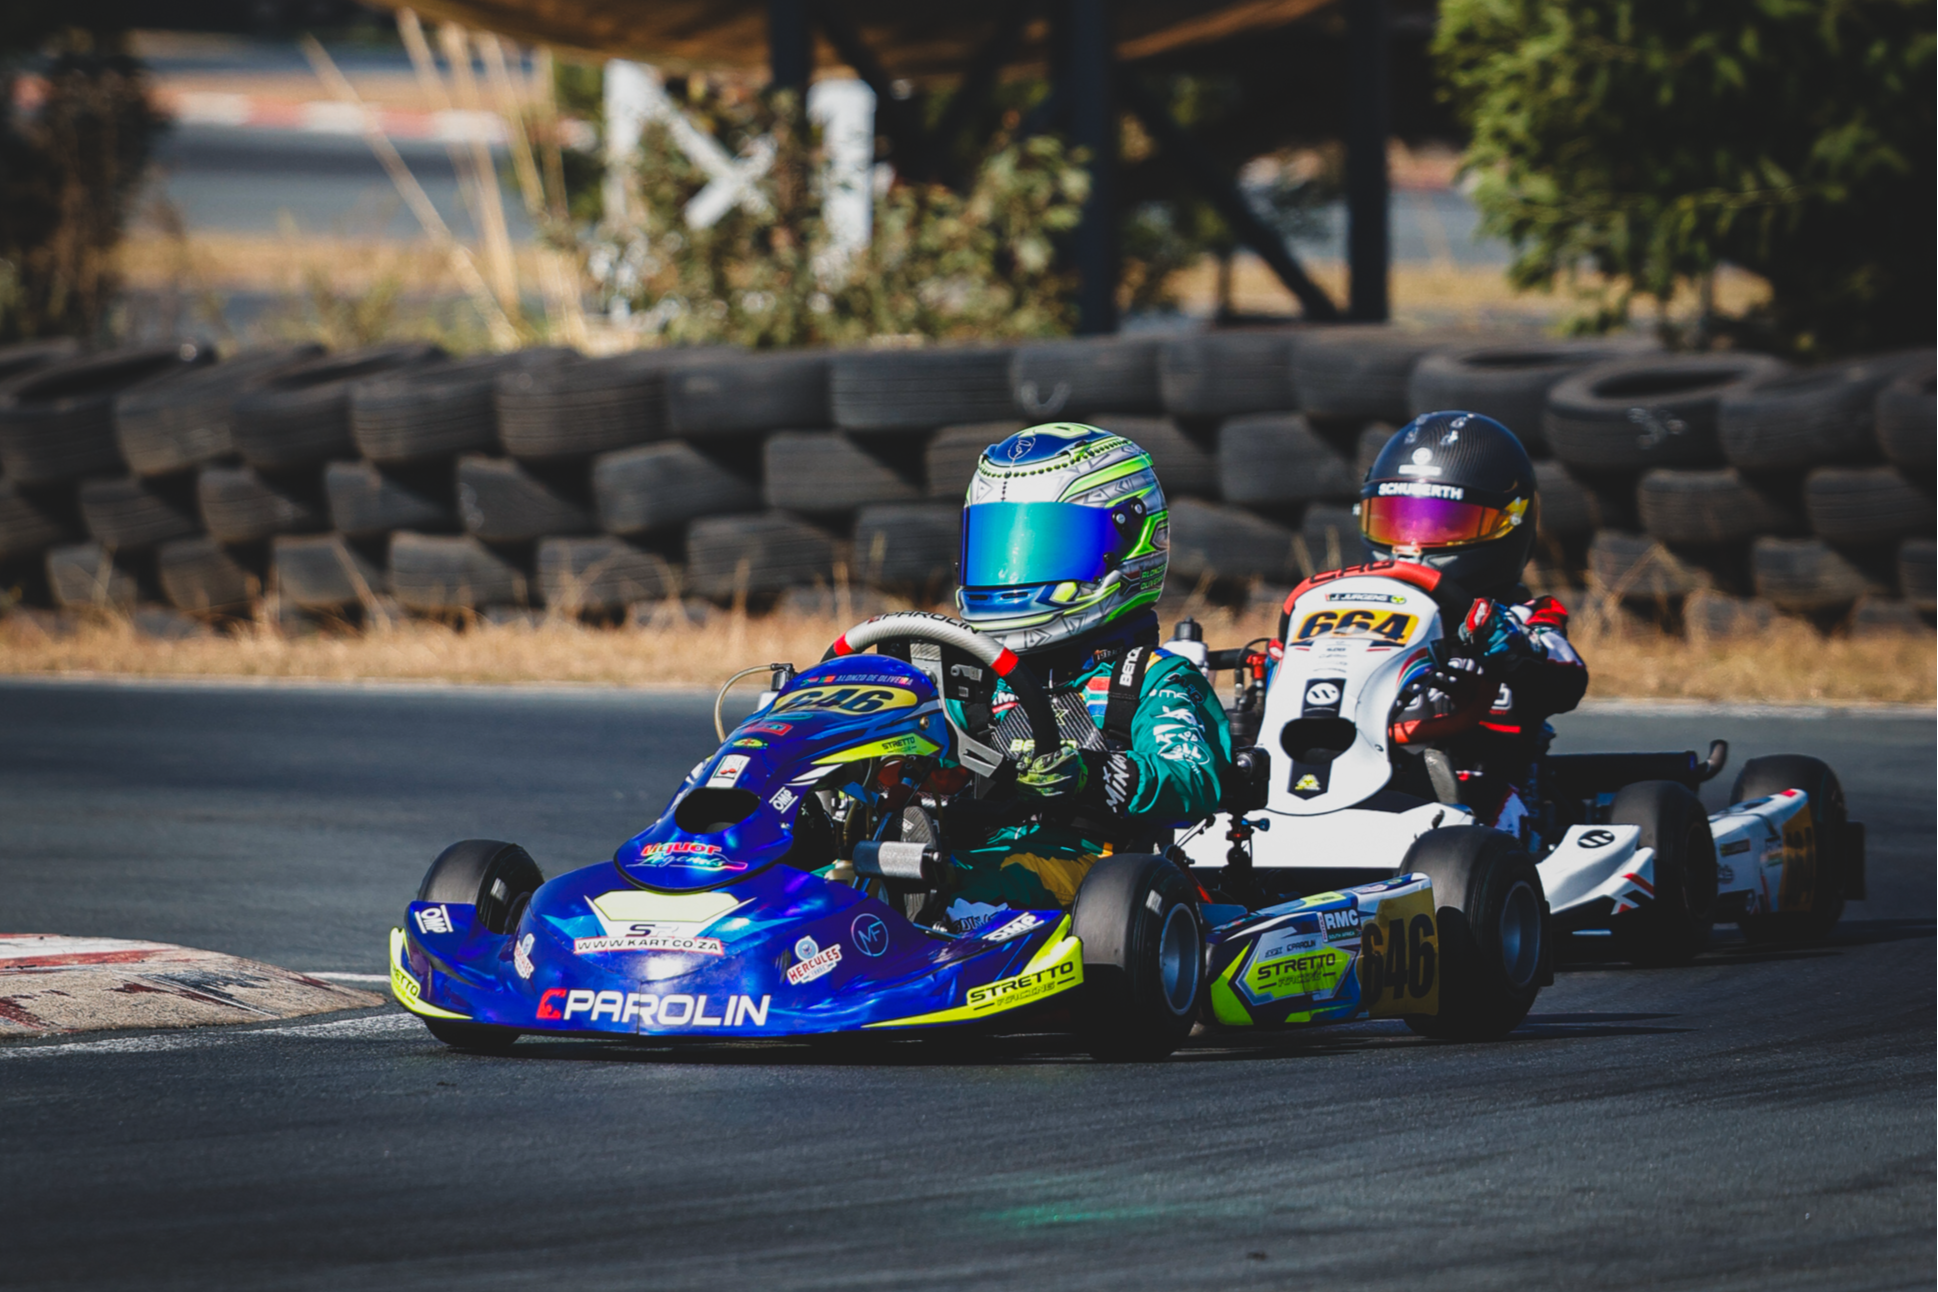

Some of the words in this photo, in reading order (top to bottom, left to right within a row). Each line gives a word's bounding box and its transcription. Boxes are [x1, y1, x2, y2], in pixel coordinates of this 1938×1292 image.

[1377, 482, 1464, 500] SCHUBERTH
[1344, 594, 1388, 602] JURGENS
[1297, 610, 1411, 640] 664
[834, 673, 863, 683] ALONZO
[863, 674, 877, 683] DE
[877, 674, 913, 686] OLIVEIRA
[772, 688, 894, 712] 646
[881, 736, 915, 750] STRETTO
[772, 789, 793, 811] OMP
[420, 907, 448, 934] OMP
[987, 914, 1040, 942] OMP
[1323, 909, 1359, 930] RMC
[788, 947, 841, 983] HERCULES
[1257, 952, 1336, 981] STRETTO
[1362, 913, 1436, 1006] 646
[970, 961, 1074, 1003] STRETTO
[996, 981, 1056, 1007] RACING
